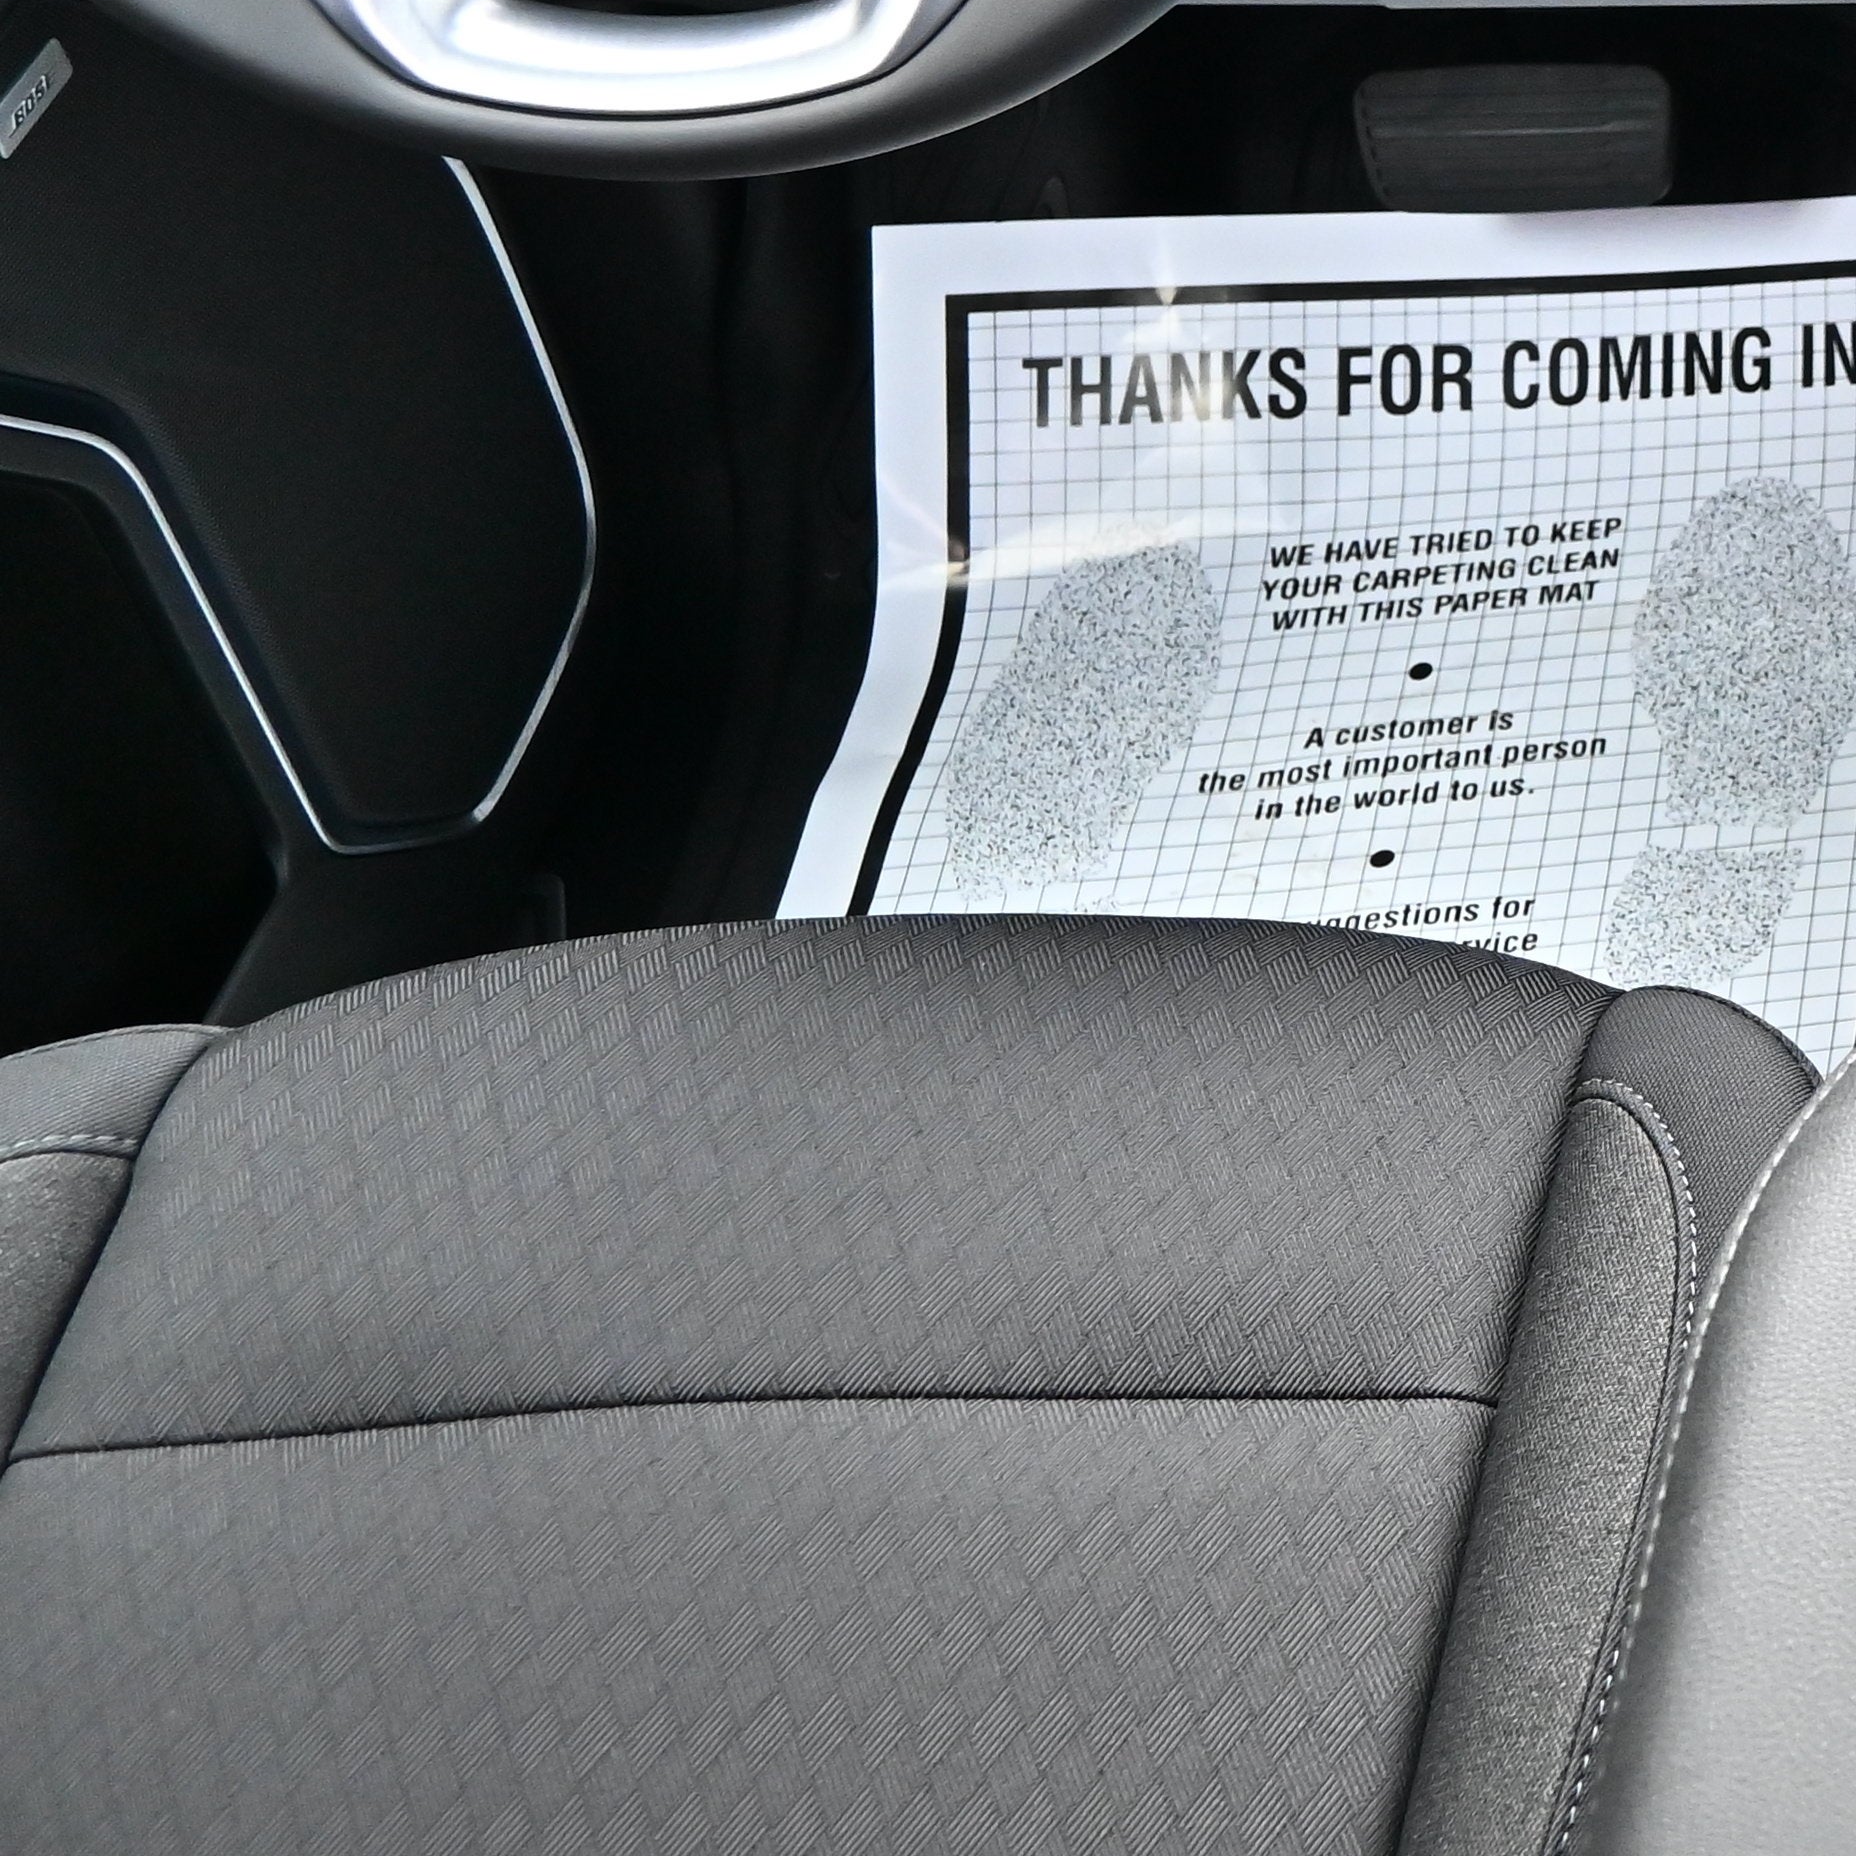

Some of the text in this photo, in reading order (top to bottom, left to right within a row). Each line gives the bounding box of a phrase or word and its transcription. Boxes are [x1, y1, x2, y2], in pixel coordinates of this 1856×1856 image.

[1022, 347, 1307, 428] THANKS
[1337, 343, 1474, 417] FOR
[1503, 326, 1772, 410] COMING
[1270, 517, 1622, 569] WE HAVE TRIED TO KEEP
[1262, 548, 1620, 601] YOUR CARPETING CLEAN
[1272, 580, 1600, 632] WITH THIS PAPER MAT
[1303, 709, 1514, 750] A customer is
[1198, 738, 1607, 795] the most important person
[1254, 776, 1536, 820] in the world to us.
[1306, 896, 1536, 930] gestions for
